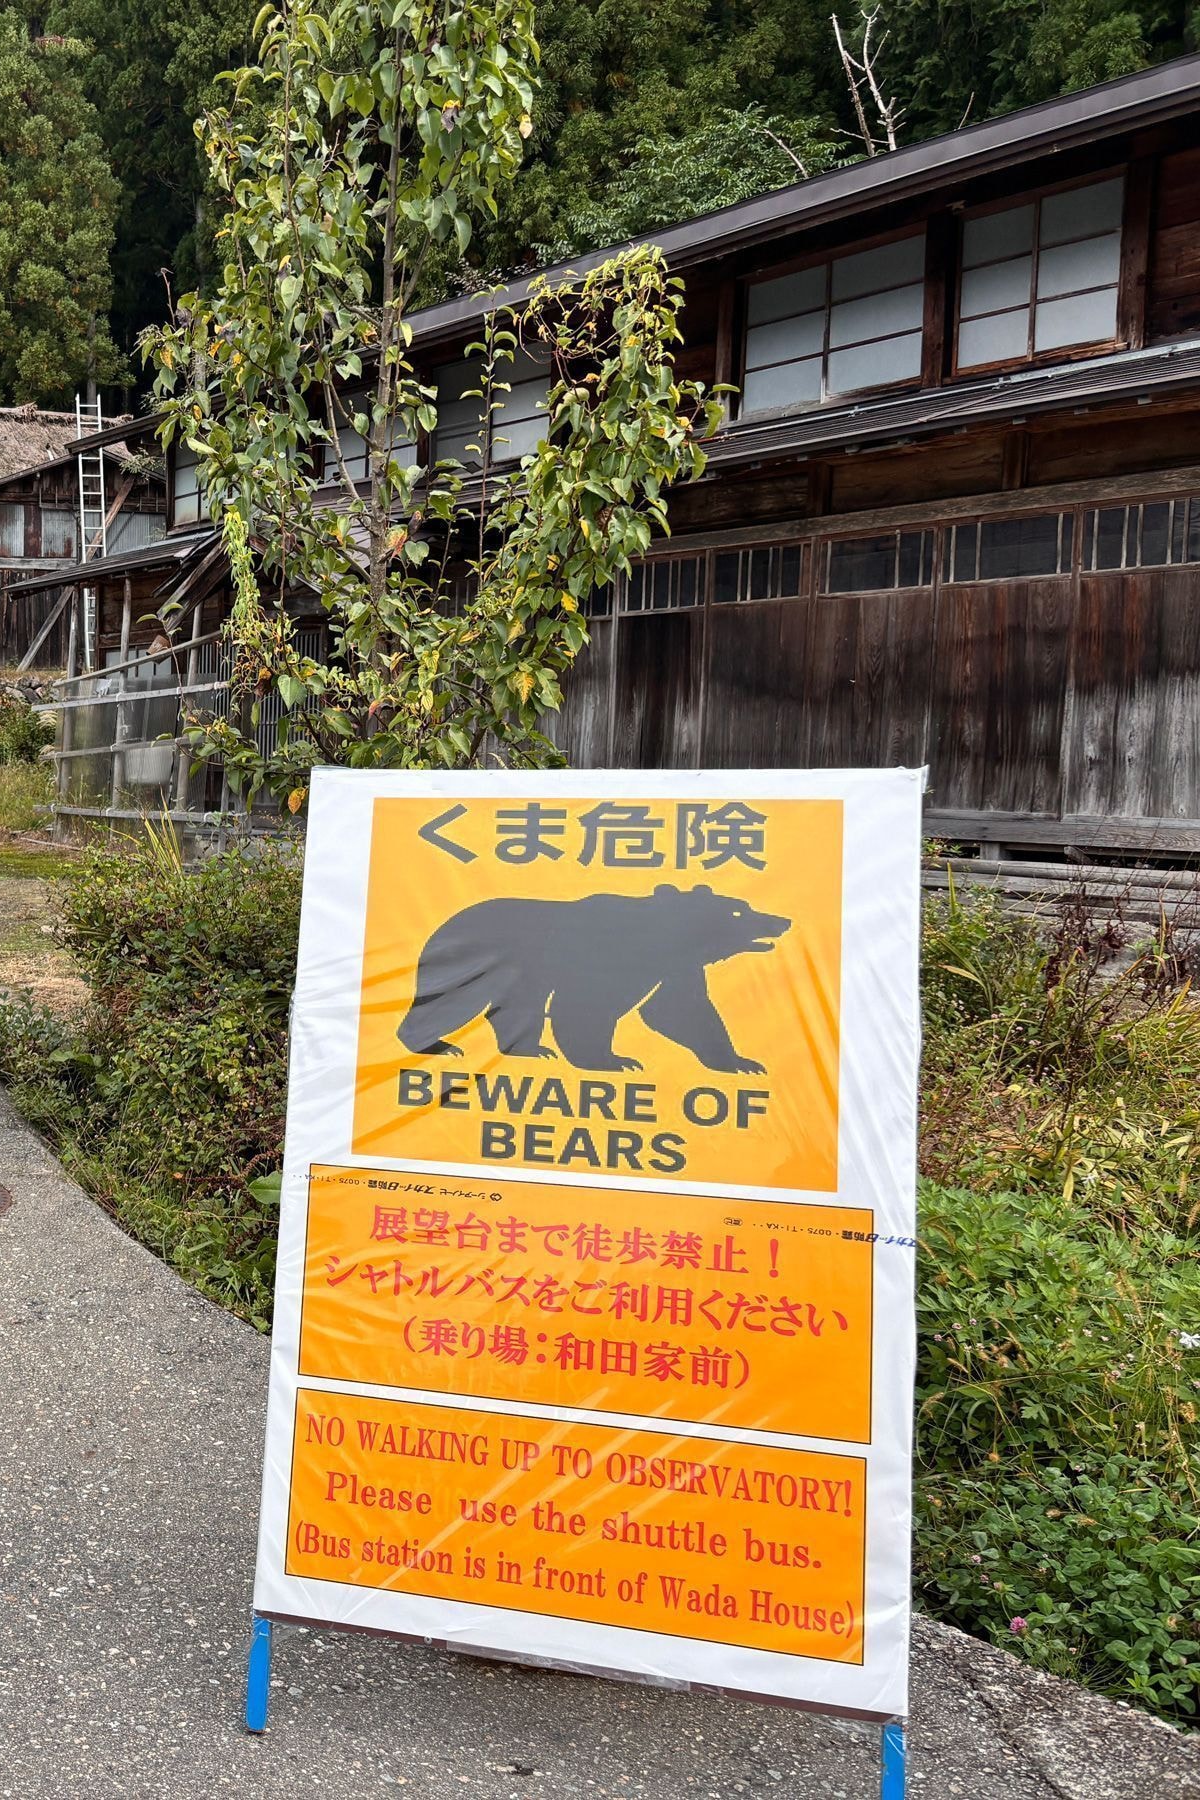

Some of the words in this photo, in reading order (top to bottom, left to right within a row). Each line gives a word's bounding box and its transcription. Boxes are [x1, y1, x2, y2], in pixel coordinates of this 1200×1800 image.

[417, 802, 768, 870] くま危険
[398, 1069, 657, 1122] BEWARE
[683, 1087, 770, 1128] OF
[481, 1122, 686, 1173] BEARS
[370, 1205, 779, 1278] 展望台まで徒歩禁止！
[324, 1255, 848, 1337] シャトルバスをご利用ください
[305, 1413, 345, 1447] NO
[356, 1419, 489, 1466] WALKING
[500, 1438, 541, 1472] UP
[551, 1444, 593, 1480] TO
[606, 1452, 852, 1517] OBSERVATORY!
[325, 1471, 432, 1514] Please
[459, 1498, 517, 1526] use
[531, 1501, 586, 1536] the
[601, 1511, 728, 1557] shuttle
[743, 1528, 822, 1569] bus.
[295, 1520, 351, 1559] (Bus
[361, 1535, 454, 1575] station
[463, 1546, 486, 1580] is
[496, 1551, 522, 1585] in
[532, 1556, 607, 1598] front
[617, 1571, 648, 1604] of
[659, 1575, 739, 1619] Wada
[749, 1589, 855, 1639] House)
